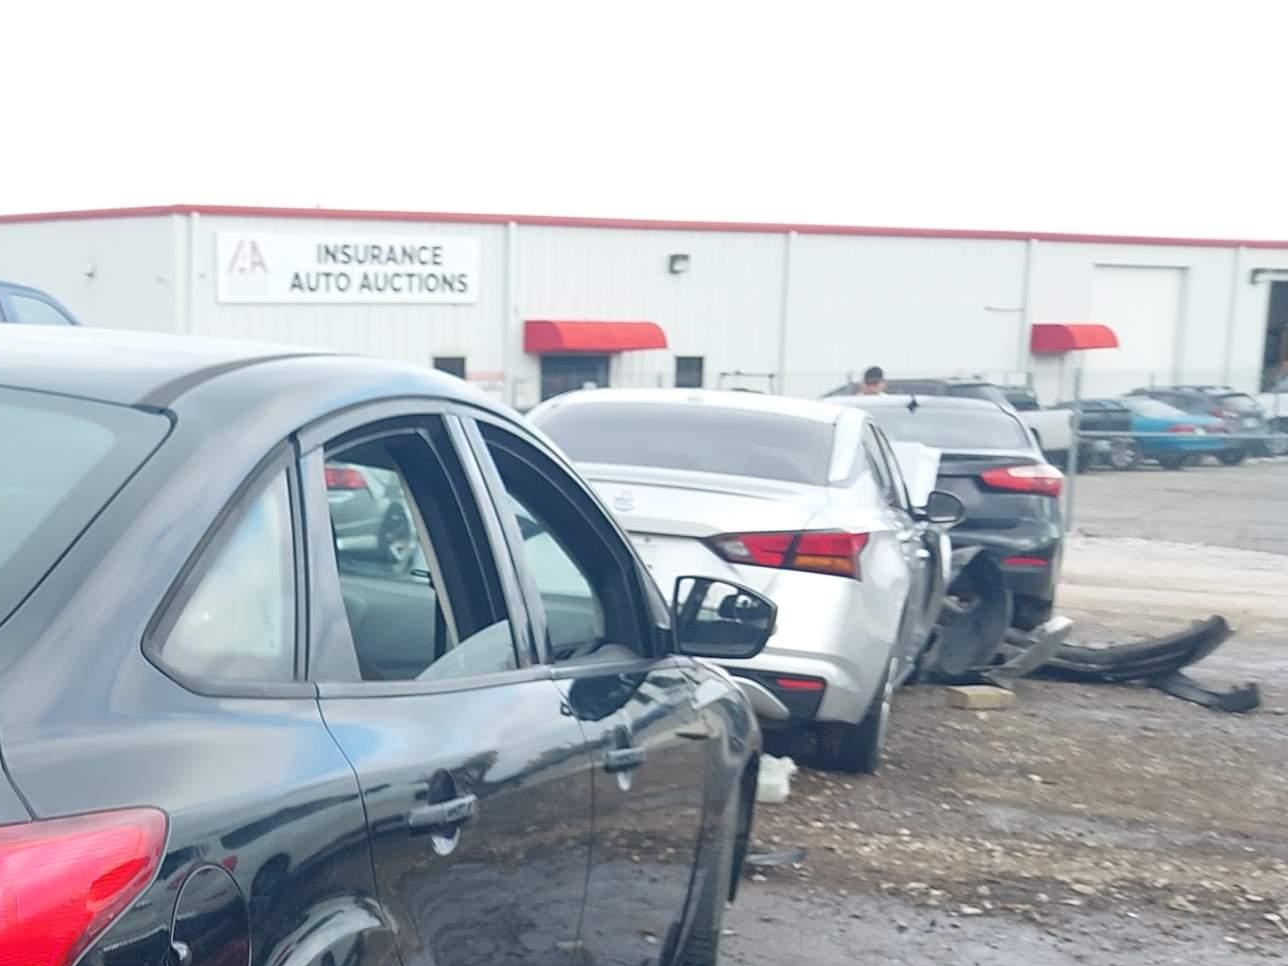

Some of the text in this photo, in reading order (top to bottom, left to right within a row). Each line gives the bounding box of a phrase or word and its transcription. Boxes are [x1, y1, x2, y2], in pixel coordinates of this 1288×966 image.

[315, 243, 444, 267] INSURANCE
[289, 271, 469, 294] AUTO AUCTIONS
